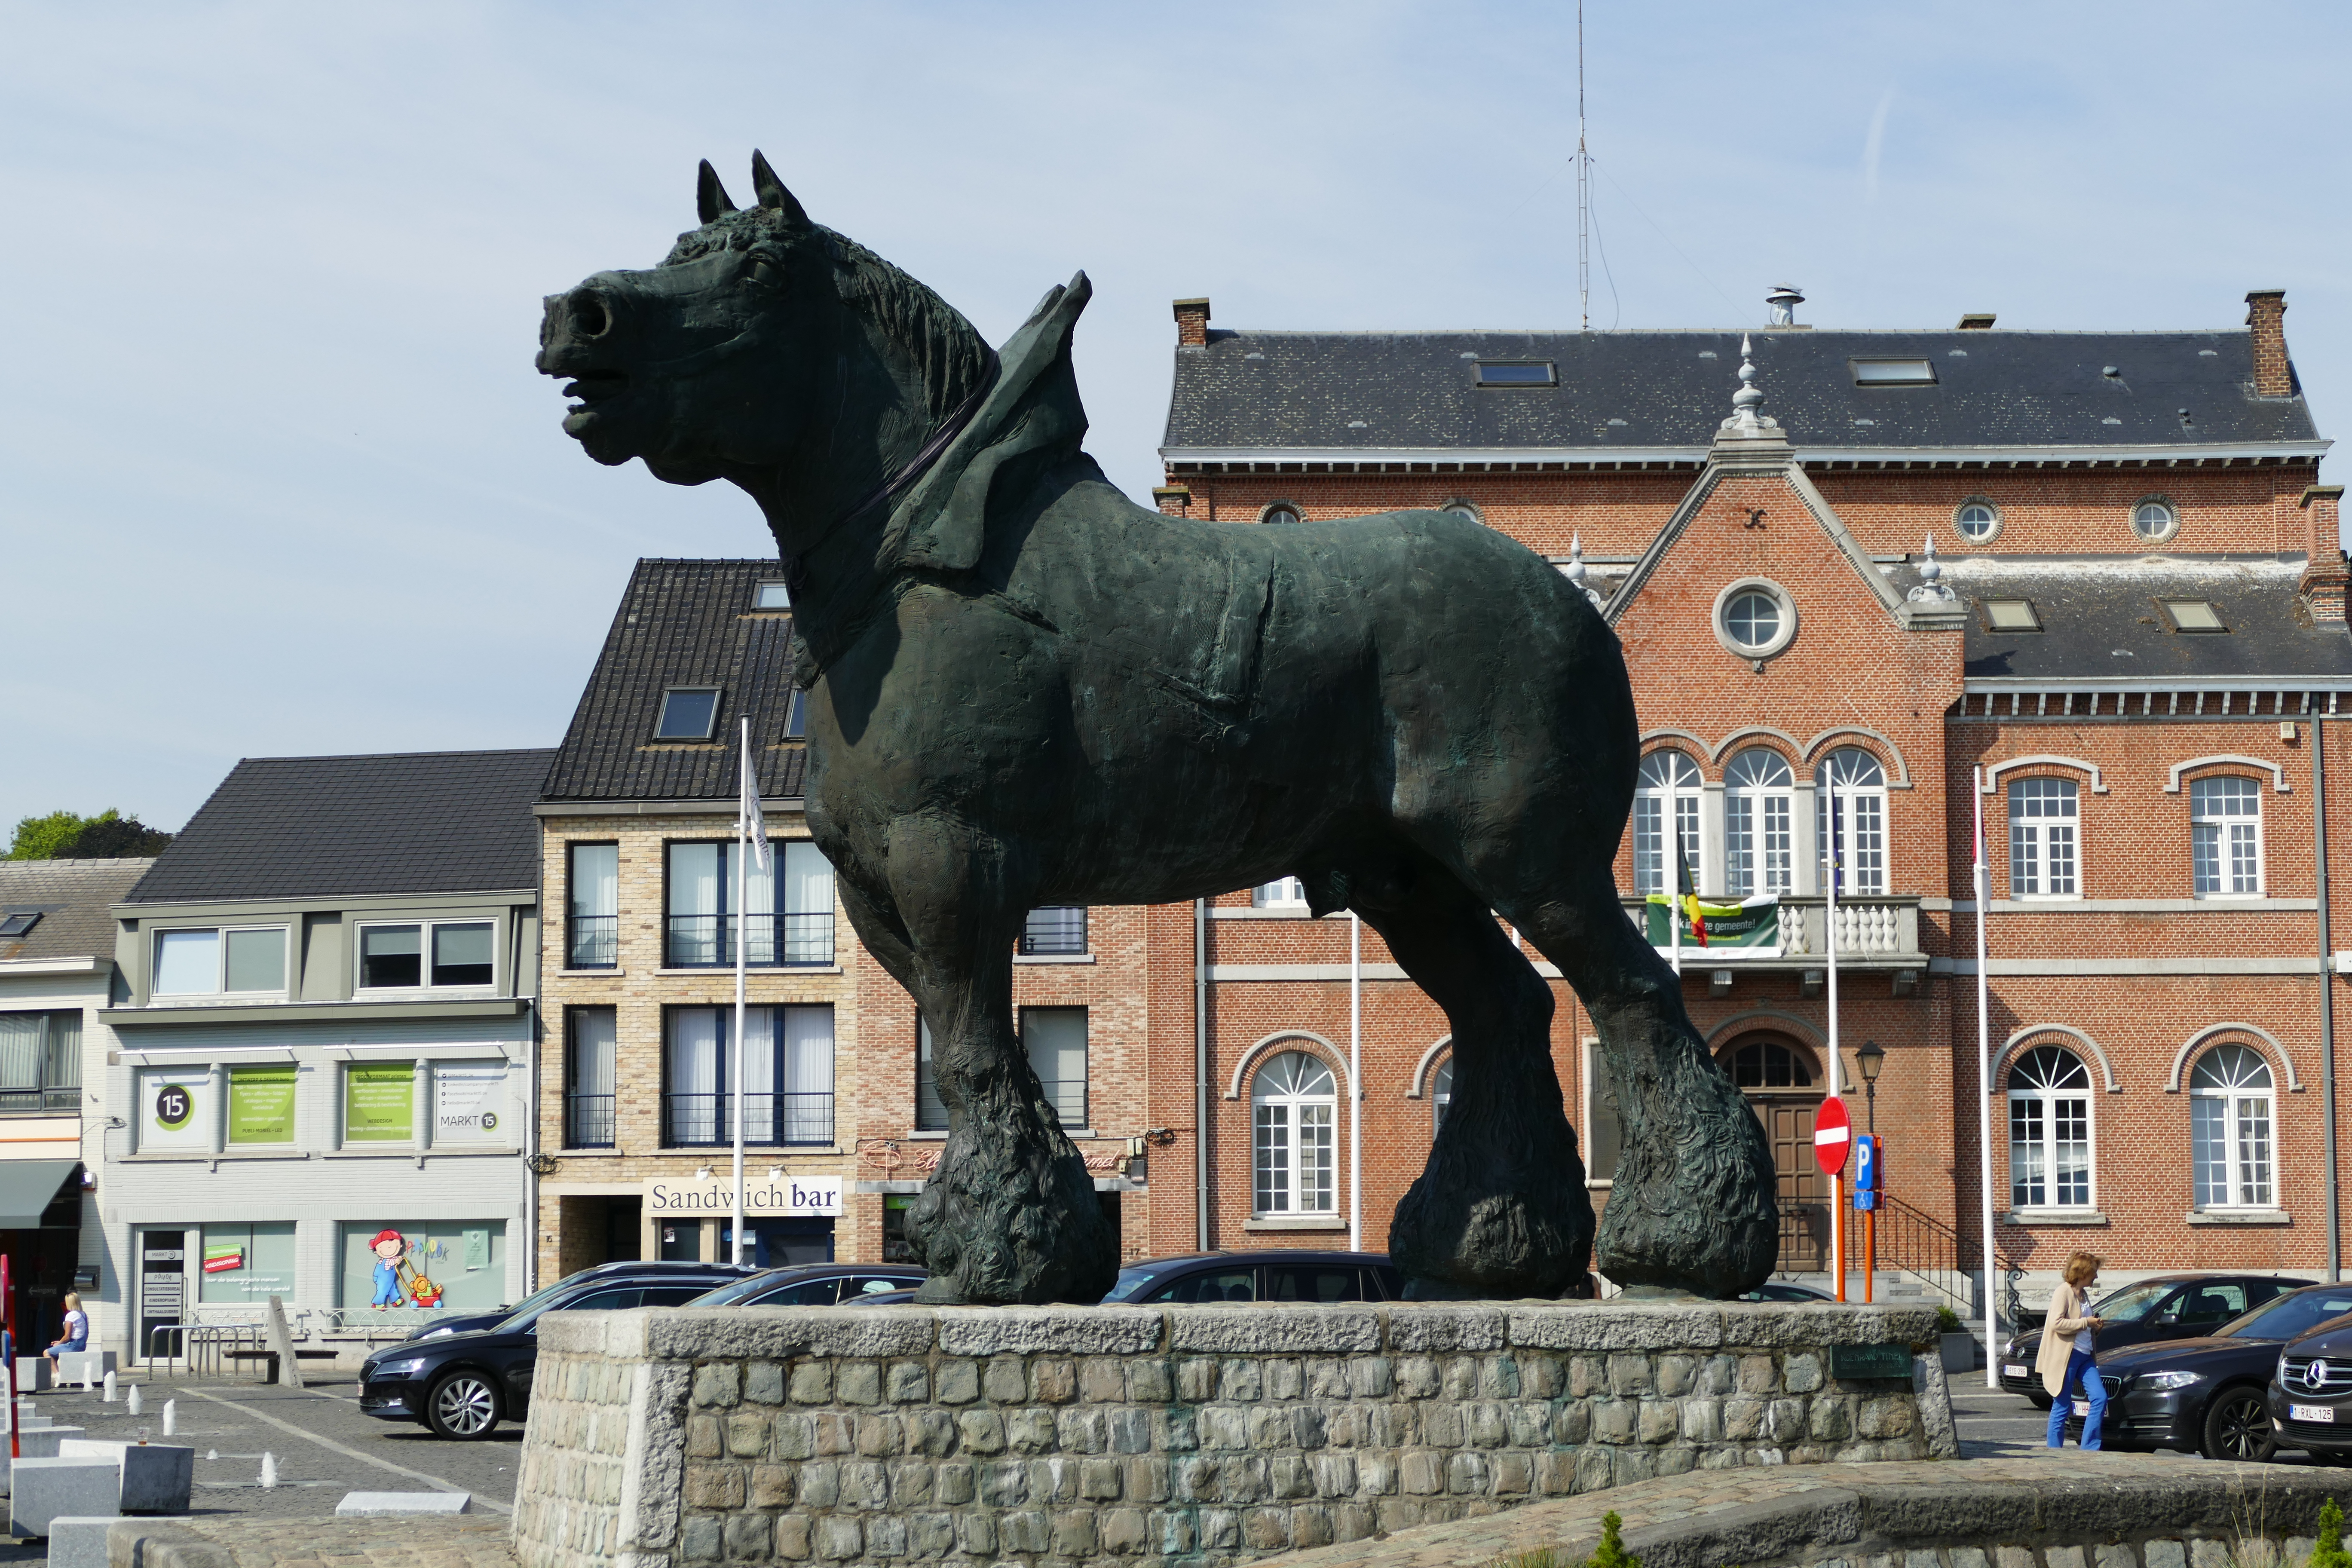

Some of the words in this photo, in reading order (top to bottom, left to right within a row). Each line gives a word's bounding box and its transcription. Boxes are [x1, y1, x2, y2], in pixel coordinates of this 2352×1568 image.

[1715, 919, 1755, 933] gemeente!
[163, 1095, 184, 1116] 15
[441, 1115, 479, 1126] MARKT
[484, 1116, 494, 1126] 15
[1858, 1144, 1869, 1181] P
[790, 1183, 836, 1207] bar
[205, 1258, 239, 1268] KINDEROPVANG
[154, 1273, 173, 1281] PAVOK
[227, 1277, 260, 1285] belangrijkste
[1841, 1354, 1878, 1362] KOENRAAD
[2294, 1407, 2331, 1420] 1-RXL-125
